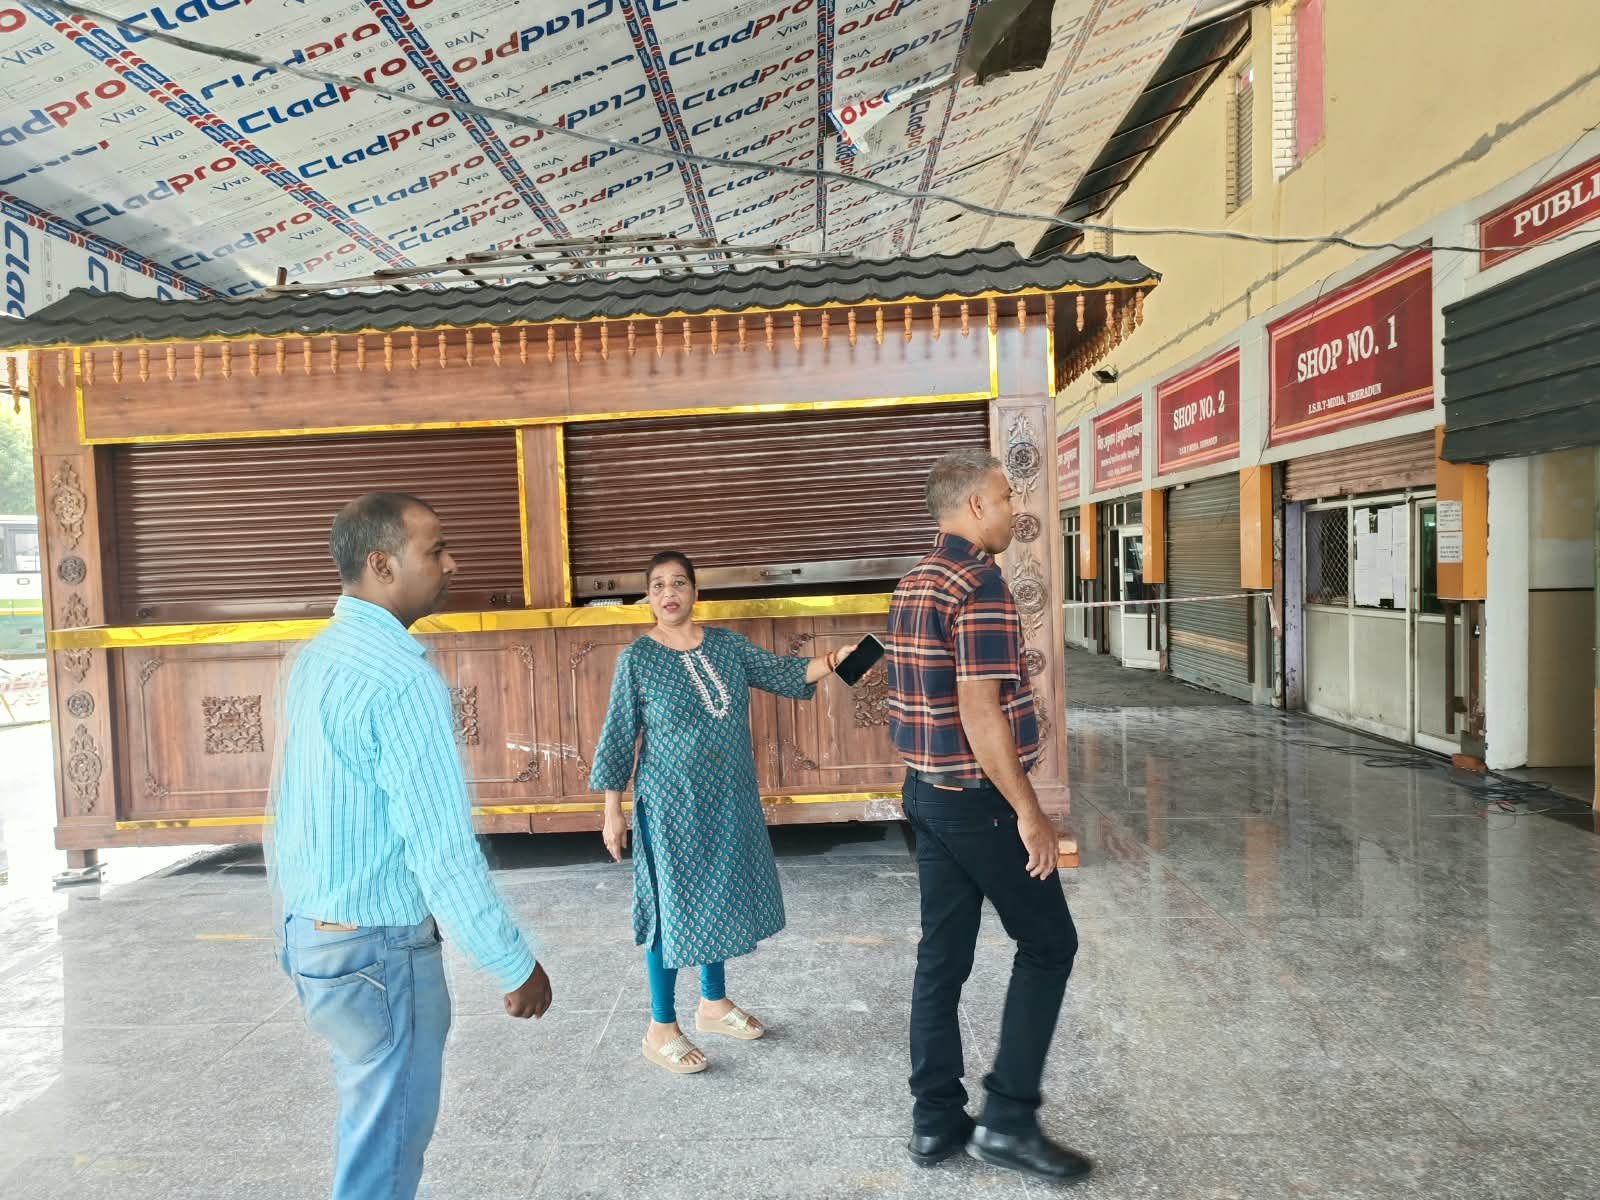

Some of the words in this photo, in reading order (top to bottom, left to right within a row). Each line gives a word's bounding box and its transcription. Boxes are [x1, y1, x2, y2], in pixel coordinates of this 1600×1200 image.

[1, 41, 55, 65] Viva
[452, 0, 613, 73] Cladpro
[669, 0, 814, 66] Cladpro
[777, 21, 807, 36] Viva
[836, 19, 963, 79] Cladpro
[682, 49, 814, 110] Cladpro
[101, 105, 147, 124] Viva
[692, 78, 815, 136] Cladpro
[140, 129, 184, 148] Viva
[299, 112, 450, 178] Cladpro
[75, 157, 237, 226] Cladpro
[212, 176, 251, 191] Viva
[348, 155, 484, 215] Cladpro
[558, 162, 674, 213] Cladpro
[715, 179, 815, 222] Cladpro
[828, 174, 920, 215] Cldpro
[171, 212, 313, 271] Cladpro
[399, 198, 520, 251] Cladpro
[601, 198, 684, 236] Cladp
[721, 203, 815, 242] Cladpro
[227, 243, 357, 297] Cldpro
[1297, 338, 1342, 383] SHOP
[1347, 325, 1379, 365] NO.
[1387, 315, 1398, 350] 1
[1173, 402, 1197, 431] SHOP
[1199, 394, 1216, 421] NO.
[1218, 390, 1225, 414] 2
